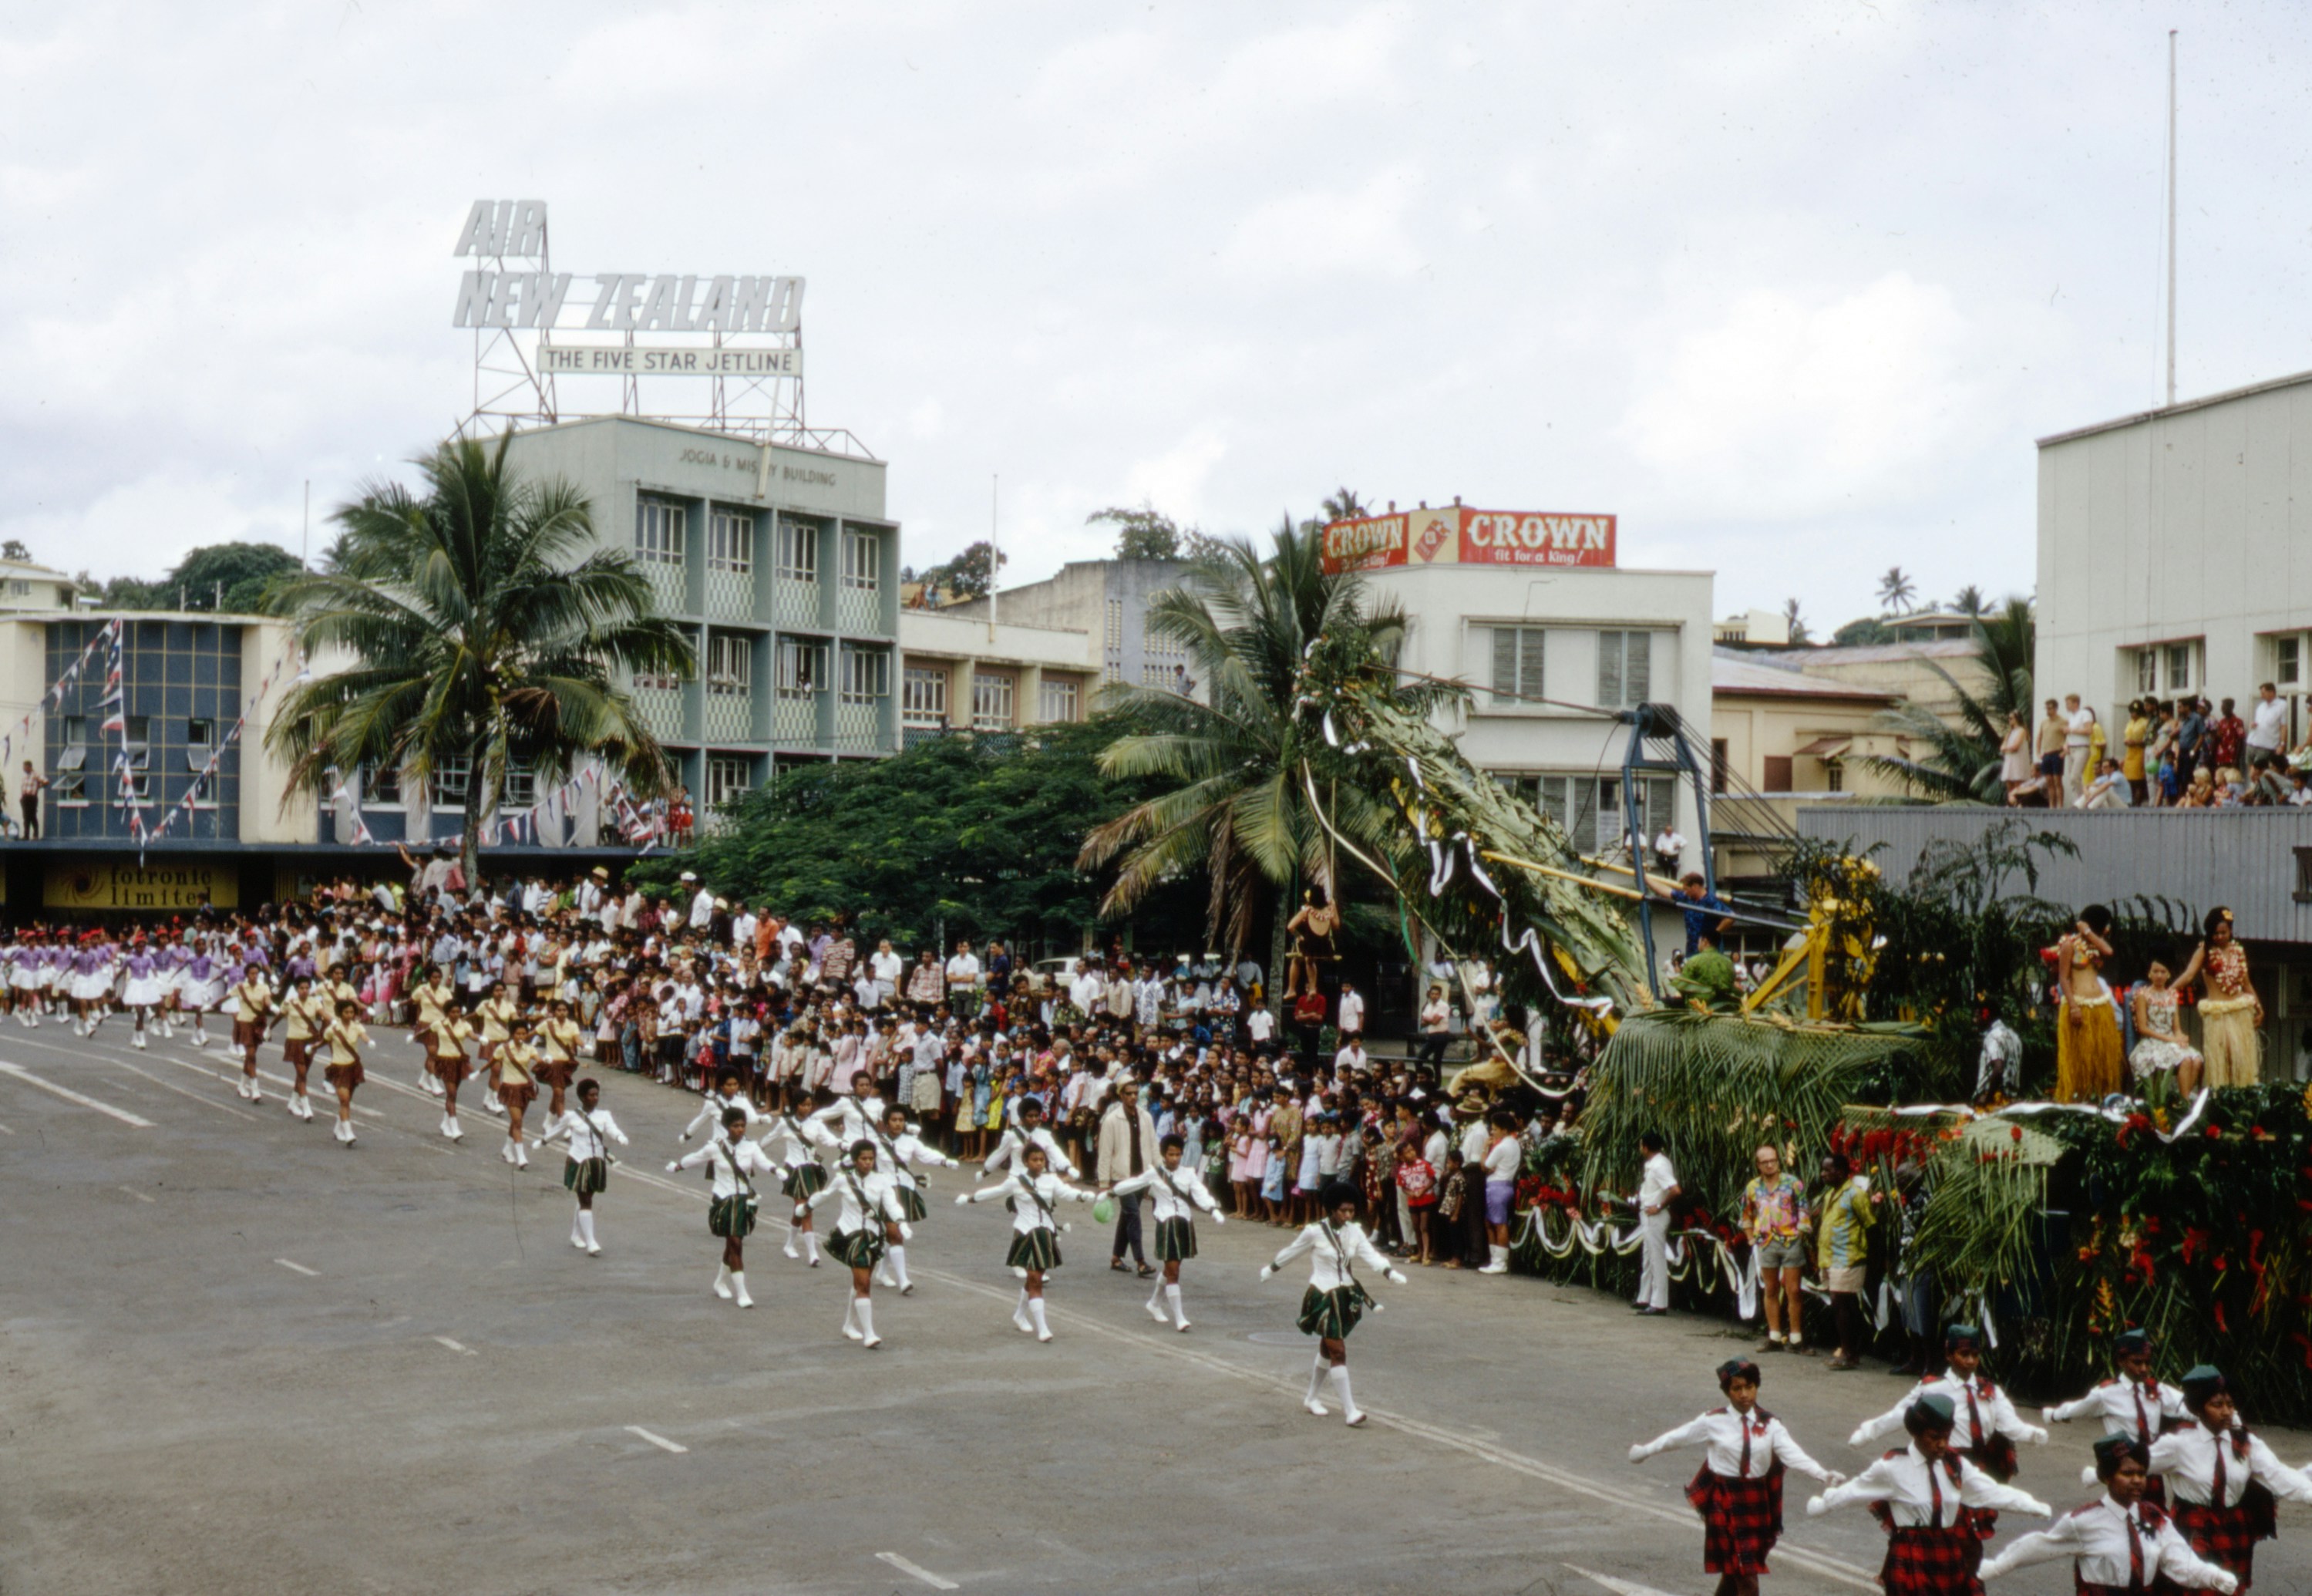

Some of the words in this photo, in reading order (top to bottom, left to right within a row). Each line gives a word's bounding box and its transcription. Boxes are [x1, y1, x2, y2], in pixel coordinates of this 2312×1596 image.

[453, 199, 547, 257] AIR
[453, 270, 572, 328] NEW
[586, 273, 805, 332] ZEALAND
[547, 350, 584, 368] THE
[593, 351, 634, 369] FIVE
[644, 352, 697, 370] STAR
[706, 352, 792, 372] JETLINE
[680, 449, 717, 466] JOGIA
[736, 457, 777, 476] MISY
[782, 465, 836, 487] BUILDING
[1327, 516, 1403, 559] CROWN
[1467, 513, 1608, 550] CROWN
[1495, 550, 1510, 562] fit
[1515, 550, 1531, 562] for
[1535, 553, 1544, 563] a
[1549, 550, 1583, 566] King!
[112, 864, 210, 886] fotronic
